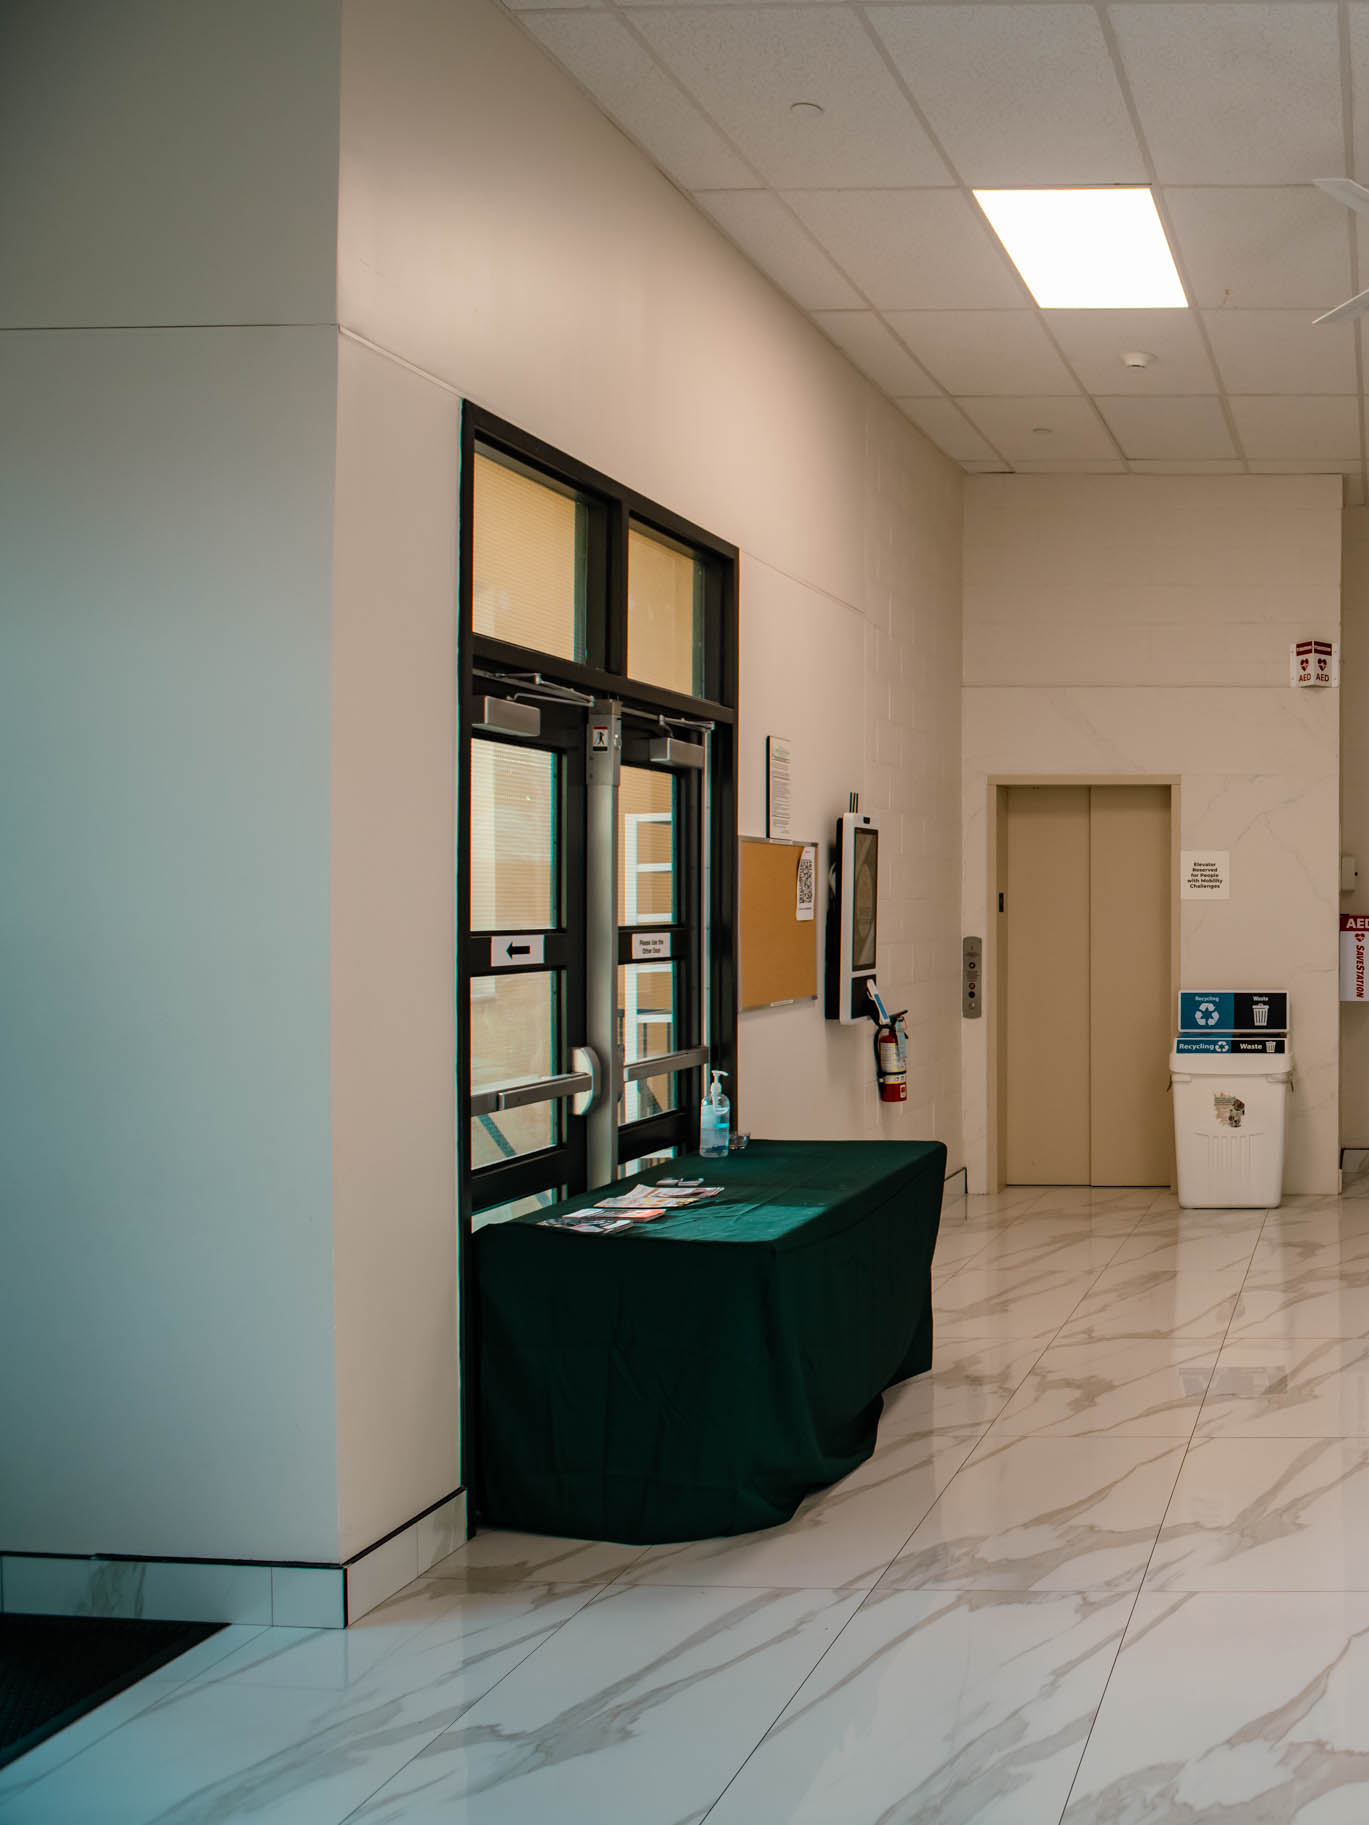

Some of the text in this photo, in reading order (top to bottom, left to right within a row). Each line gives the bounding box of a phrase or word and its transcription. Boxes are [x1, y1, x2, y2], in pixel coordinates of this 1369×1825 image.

[1298, 673, 1311, 682] AED
[1315, 673, 1329, 682] AED
[1356, 944, 1365, 998] SAVESTATION
